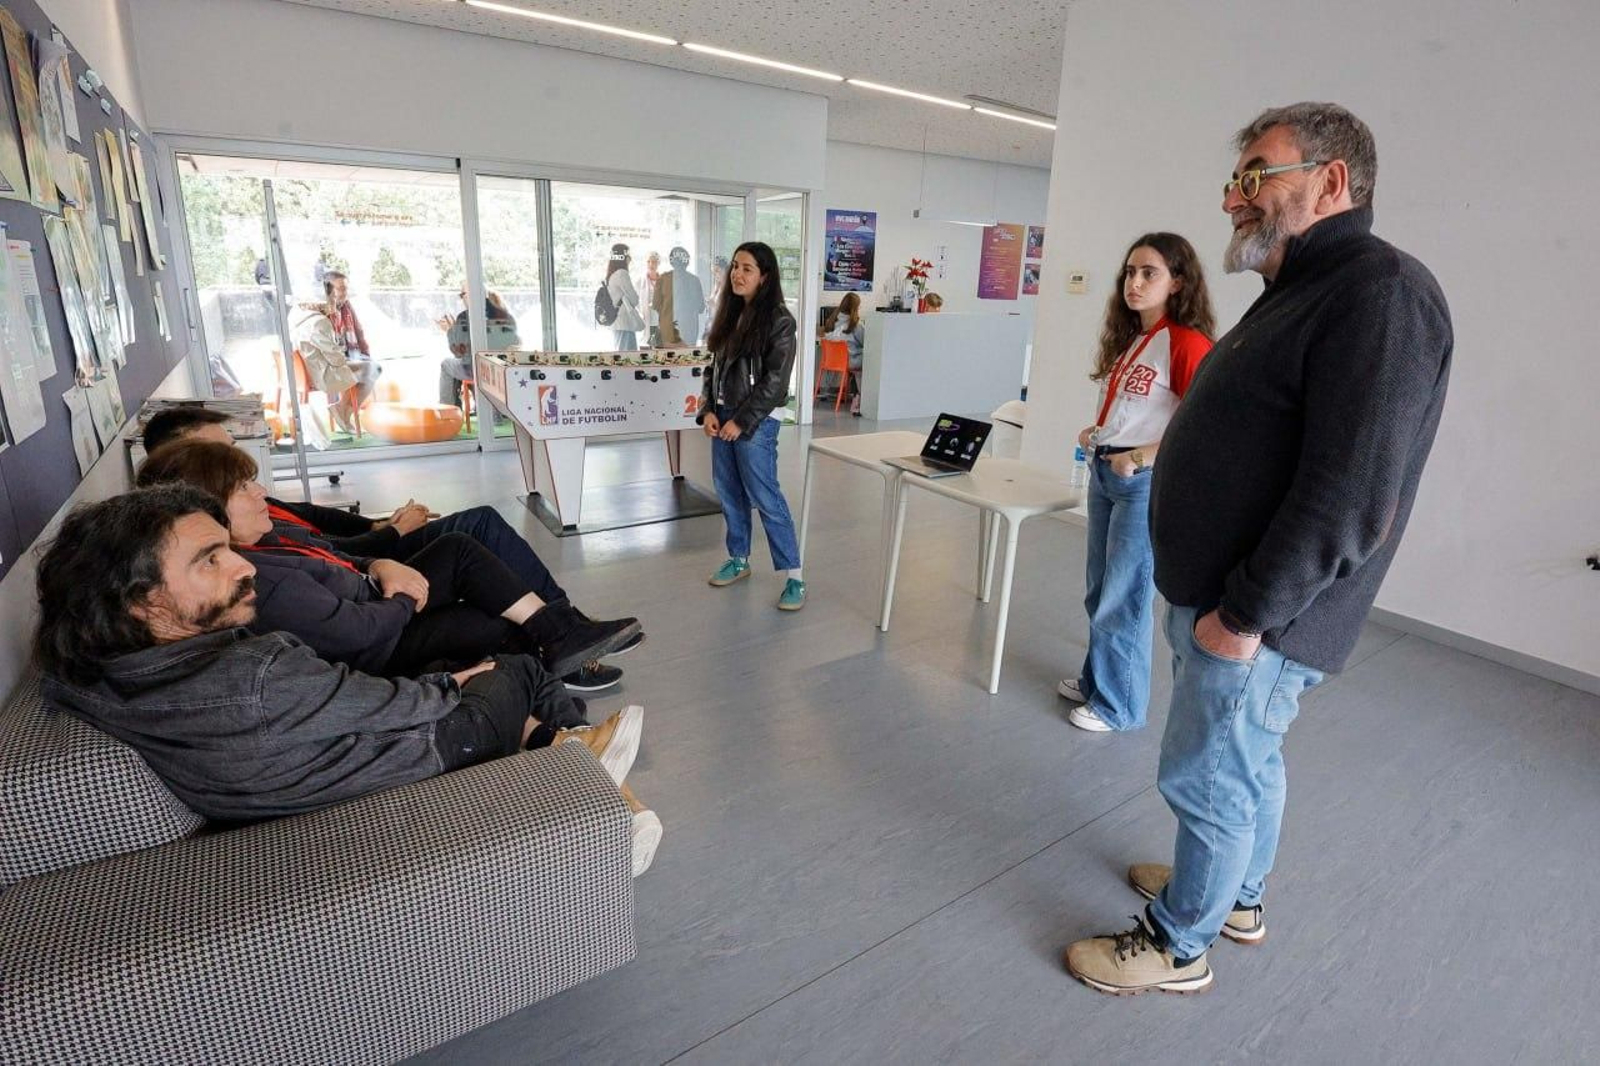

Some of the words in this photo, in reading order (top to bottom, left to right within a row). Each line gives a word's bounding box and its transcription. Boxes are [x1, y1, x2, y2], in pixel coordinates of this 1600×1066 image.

[1132, 367, 1153, 381] 20
[1127, 378, 1148, 394] 25
[584, 406, 627, 415] NACIONAL
[562, 417, 576, 425] DE
